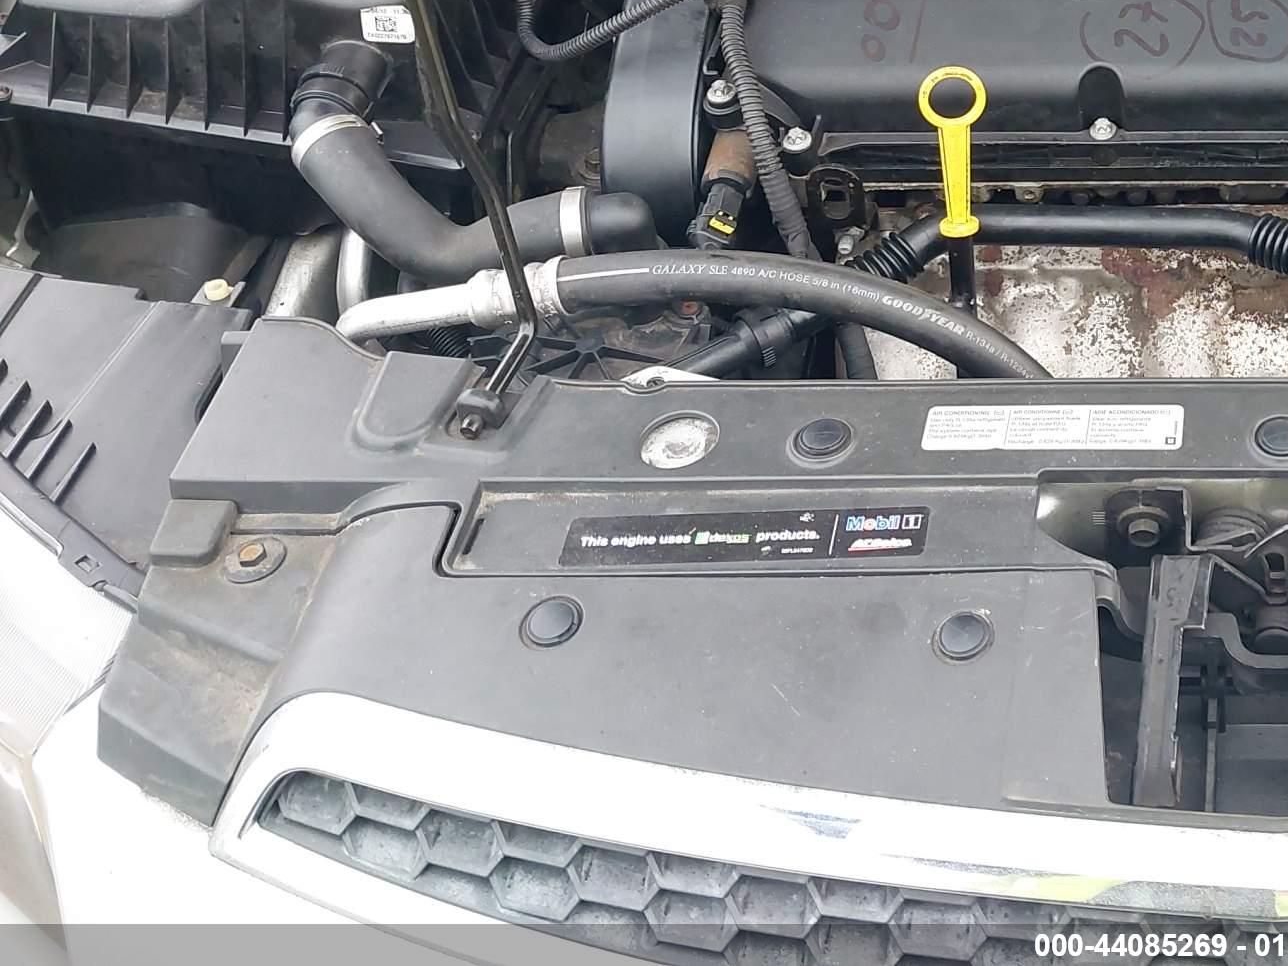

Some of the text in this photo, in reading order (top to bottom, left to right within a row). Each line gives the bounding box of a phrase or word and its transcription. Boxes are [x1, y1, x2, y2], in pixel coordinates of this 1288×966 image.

[1113, 0, 1169, 57] 27
[652, 264, 706, 275] GALAXY
[709, 265, 728, 275] SLE
[731, 267, 755, 276] 4890
[758, 268, 777, 278] A/C
[779, 271, 809, 284] HOSE
[812, 277, 829, 287] 5/8
[842, 283, 880, 303] (16mm)
[882, 294, 966, 336] GOODYEAR
[580, 535, 609, 547] This
[611, 534, 657, 548] engine
[659, 534, 692, 545] uses
[756, 528, 820, 542] products.
[845, 515, 901, 531] Mobil
